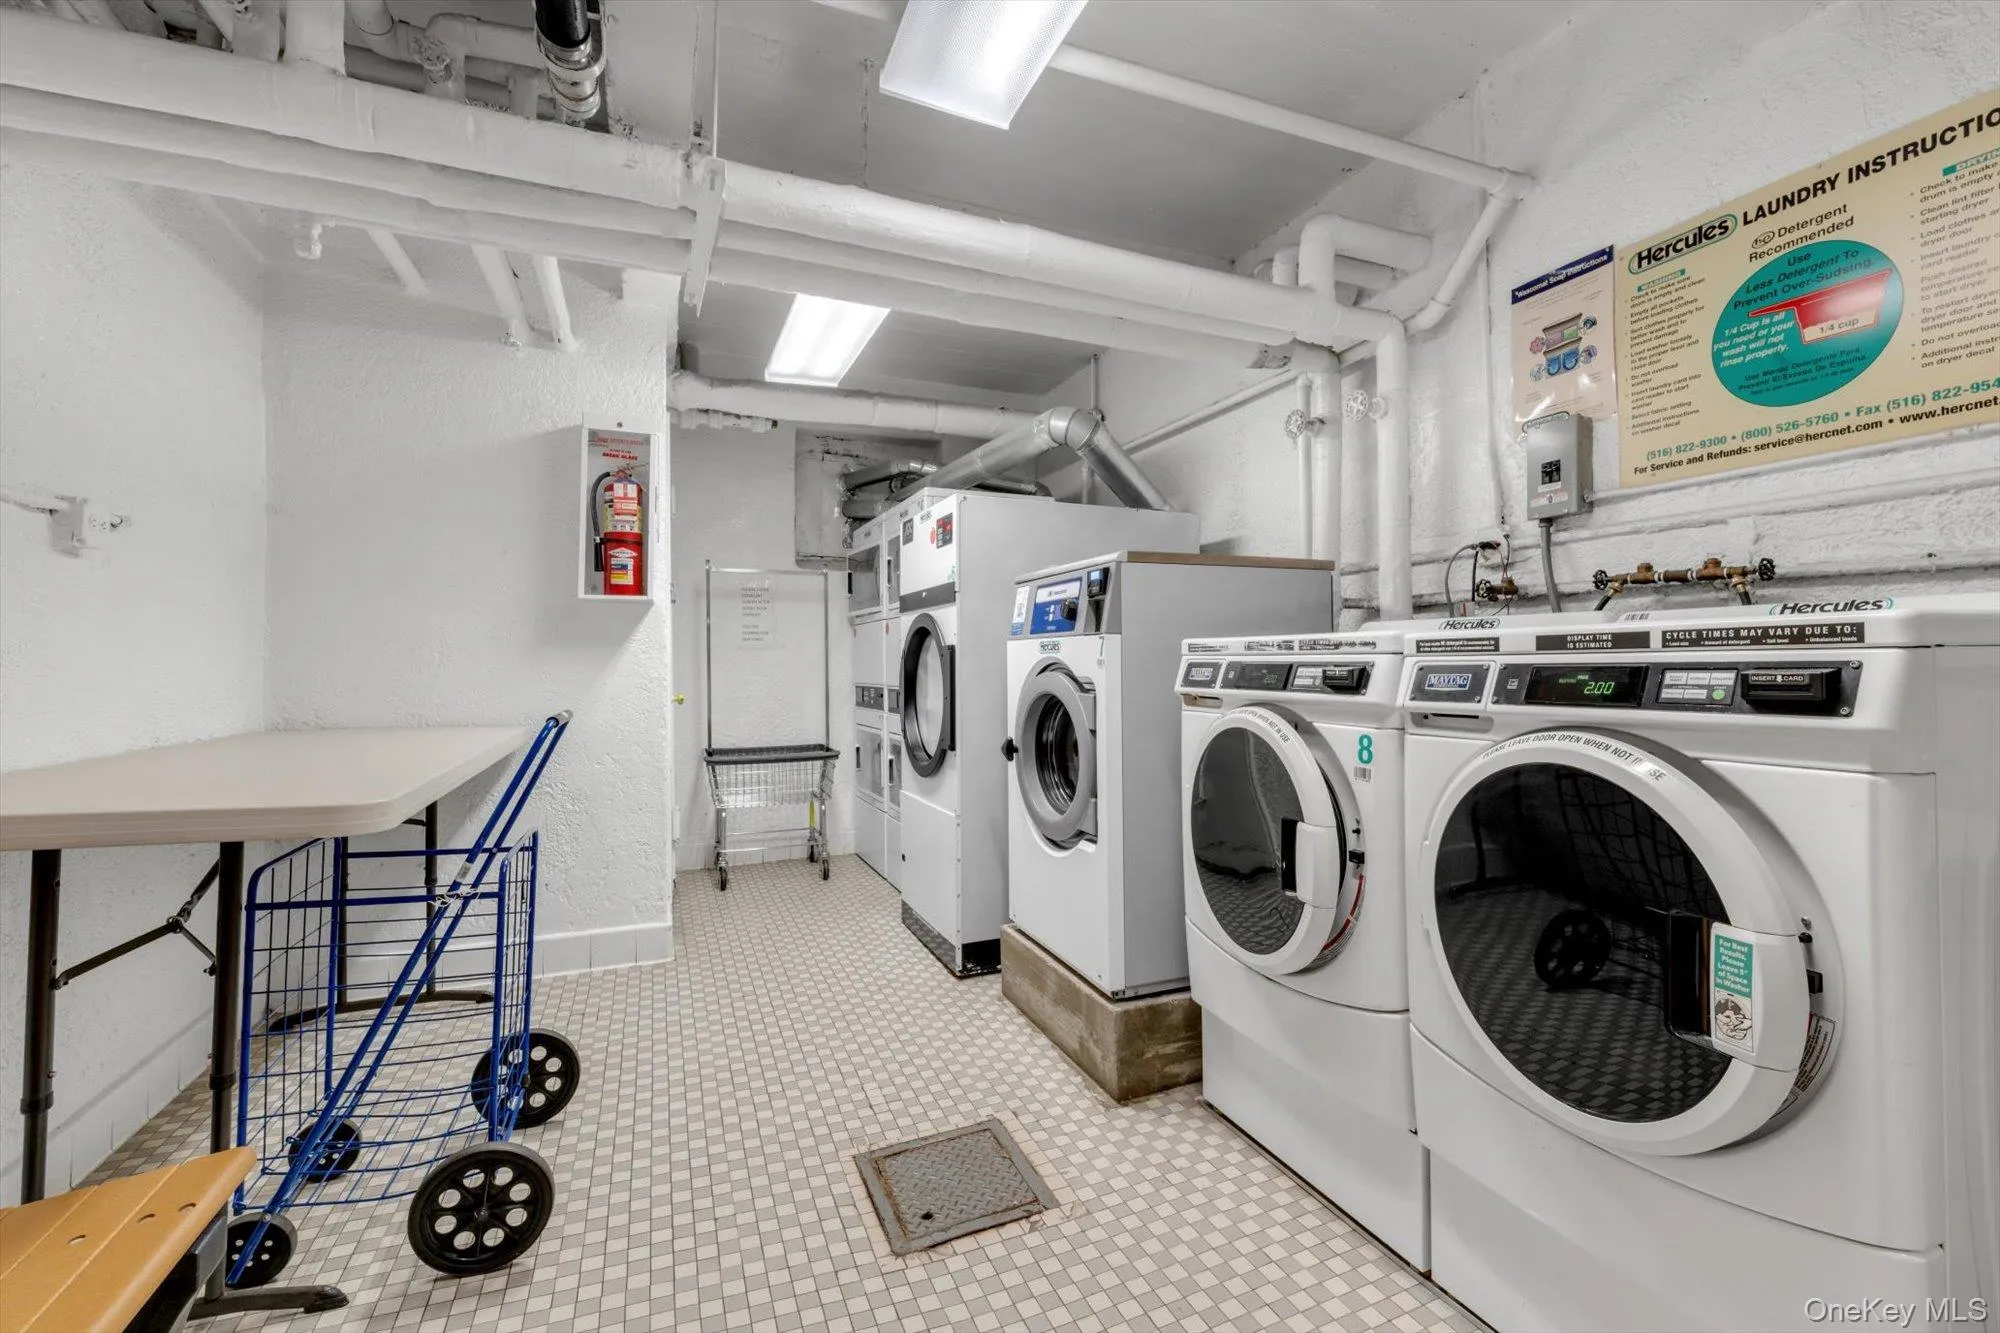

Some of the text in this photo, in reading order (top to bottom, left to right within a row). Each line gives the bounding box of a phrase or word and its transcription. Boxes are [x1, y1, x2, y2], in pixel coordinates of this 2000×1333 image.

[1920, 160, 1997, 194] Check to make
[1920, 171, 1993, 204] drum is empty
[1920, 185, 1994, 216] Clean lint filter
[1920, 197, 1988, 226] starting dryer
[1637, 219, 1729, 268] Hercules
[1742, 172, 1838, 226] LAUNDRY
[1778, 202, 1847, 239] Detergent
[1920, 211, 1985, 239] Load clothes
[1749, 215, 1853, 262] Recommended
[1746, 247, 1858, 294] Less Detergent To
[1787, 250, 1811, 267] Use
[1733, 288, 1777, 310] Prevent
[1714, 319, 1793, 351] you need or your
[1724, 310, 1784, 337] 1/4 Cup is all
[1819, 316, 1858, 334] 1/4 cup
[1723, 333, 1783, 357] wash will not
[1921, 332, 1954, 346] Do not
[1921, 341, 1972, 359] Additional
[1921, 346, 1994, 368] on dryer decal
[1646, 446, 1671, 461] (516)
[1675, 434, 1726, 454] 822-9300
[1741, 424, 1771, 442] (800)
[1776, 411, 1838, 434] 526-5760
[1856, 402, 1880, 417] Fax
[1887, 392, 1925, 413] (516)
[1634, 465, 1647, 474] For
[1650, 457, 1683, 471] Service
[1686, 453, 1703, 465] and
[1707, 444, 1750, 460] Refunds:
[1754, 418, 1882, 452] service@hercnet.com
[1779, 599, 1883, 615] Hercules
[1444, 619, 1496, 630] Hercules
[1666, 625, 1857, 639] CYCLE TIMES MAY VARY DUE TO:
[1428, 675, 1468, 685] MAYTAG
[1584, 682, 1614, 694] 2.00
[1358, 735, 1373, 764] 8
[1507, 737, 1531, 748] LEAVE
[1532, 734, 1556, 742] DOOR
[1558, 734, 1581, 743] OPEN
[1582, 737, 1613, 752] WHEN
[1610, 748, 1635, 761] NOT
[1718, 962, 1738, 974] Leave
[1722, 955, 1744, 968] Please
[1724, 980, 1748, 992] Washer
